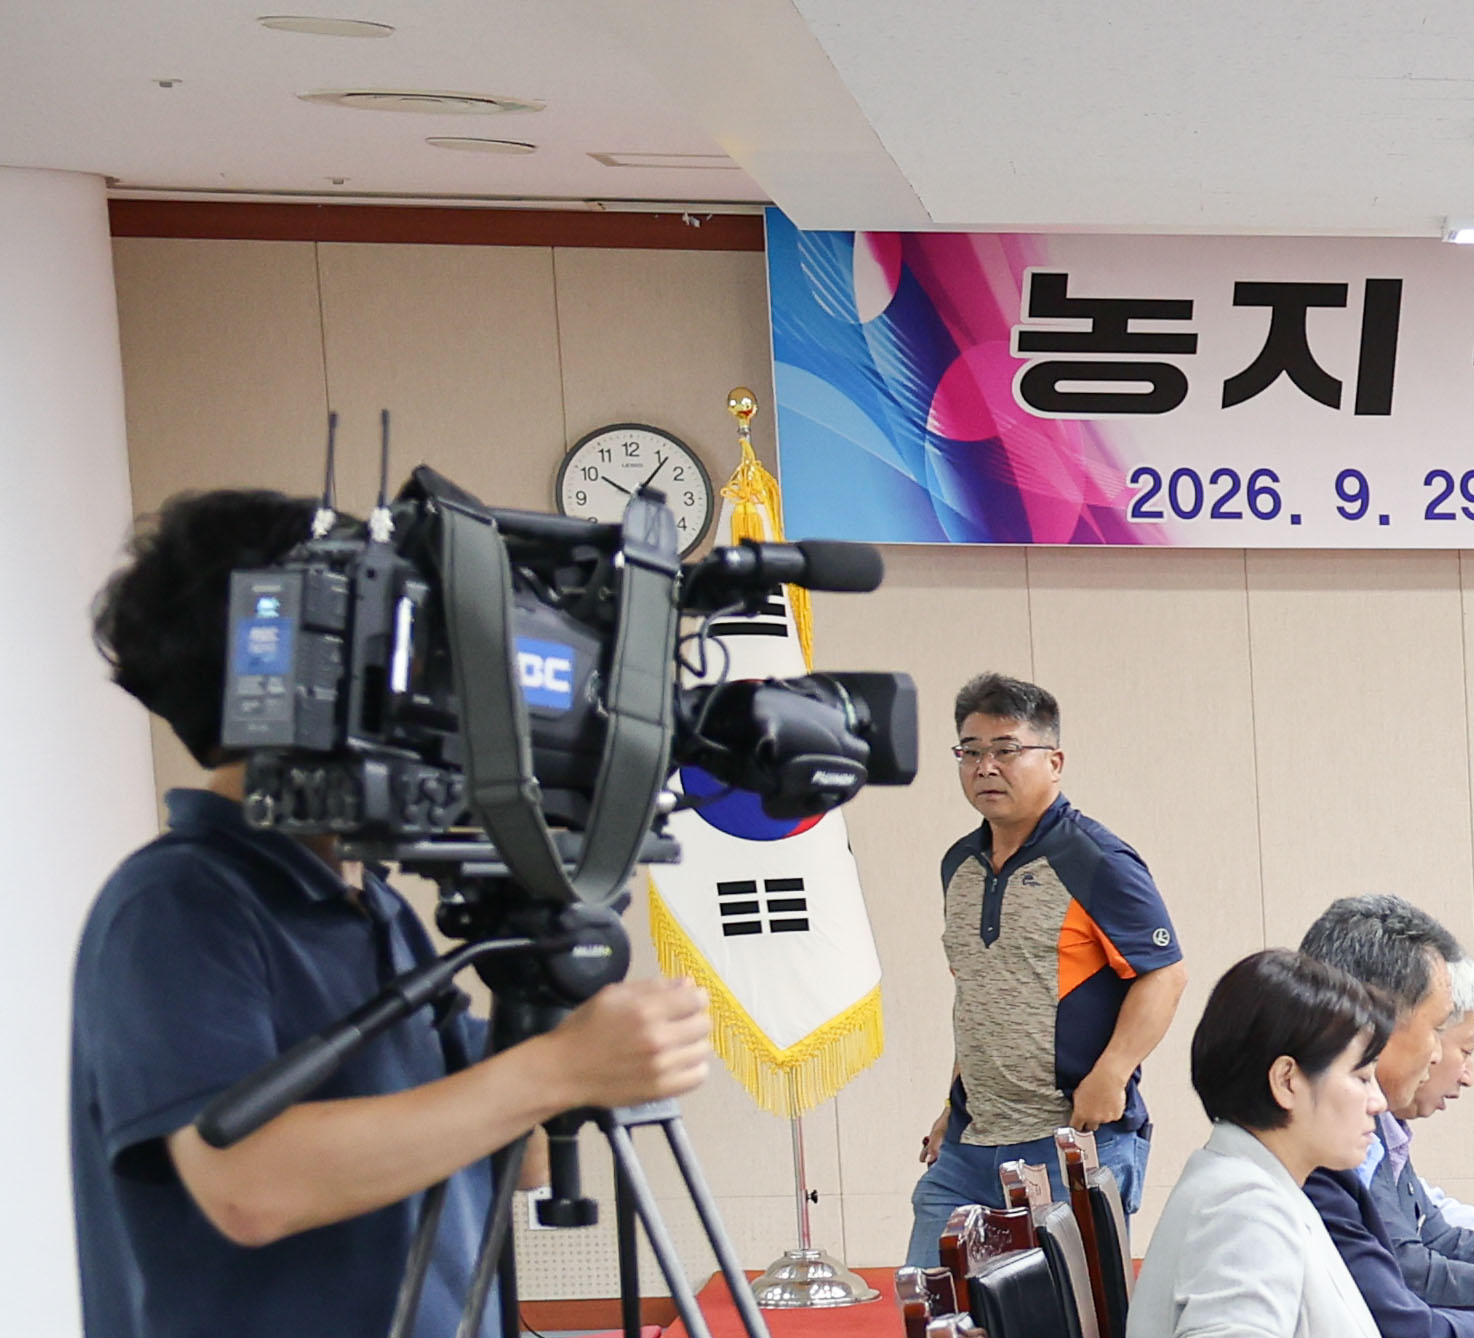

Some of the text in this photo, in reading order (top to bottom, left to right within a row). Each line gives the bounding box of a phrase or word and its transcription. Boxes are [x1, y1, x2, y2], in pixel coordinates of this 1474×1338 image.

[1017, 271, 1404, 416] 농지
[598, 448, 612, 463] 11
[622, 442, 640, 457] 12
[581, 466, 599, 481] 10
[673, 466, 684, 481] 2
[575, 491, 587, 506] 9
[683, 491, 695, 506] 3
[1128, 467, 1302, 526] 2026.
[1336, 468, 1390, 526] 9.
[677, 517, 687, 531] 4
